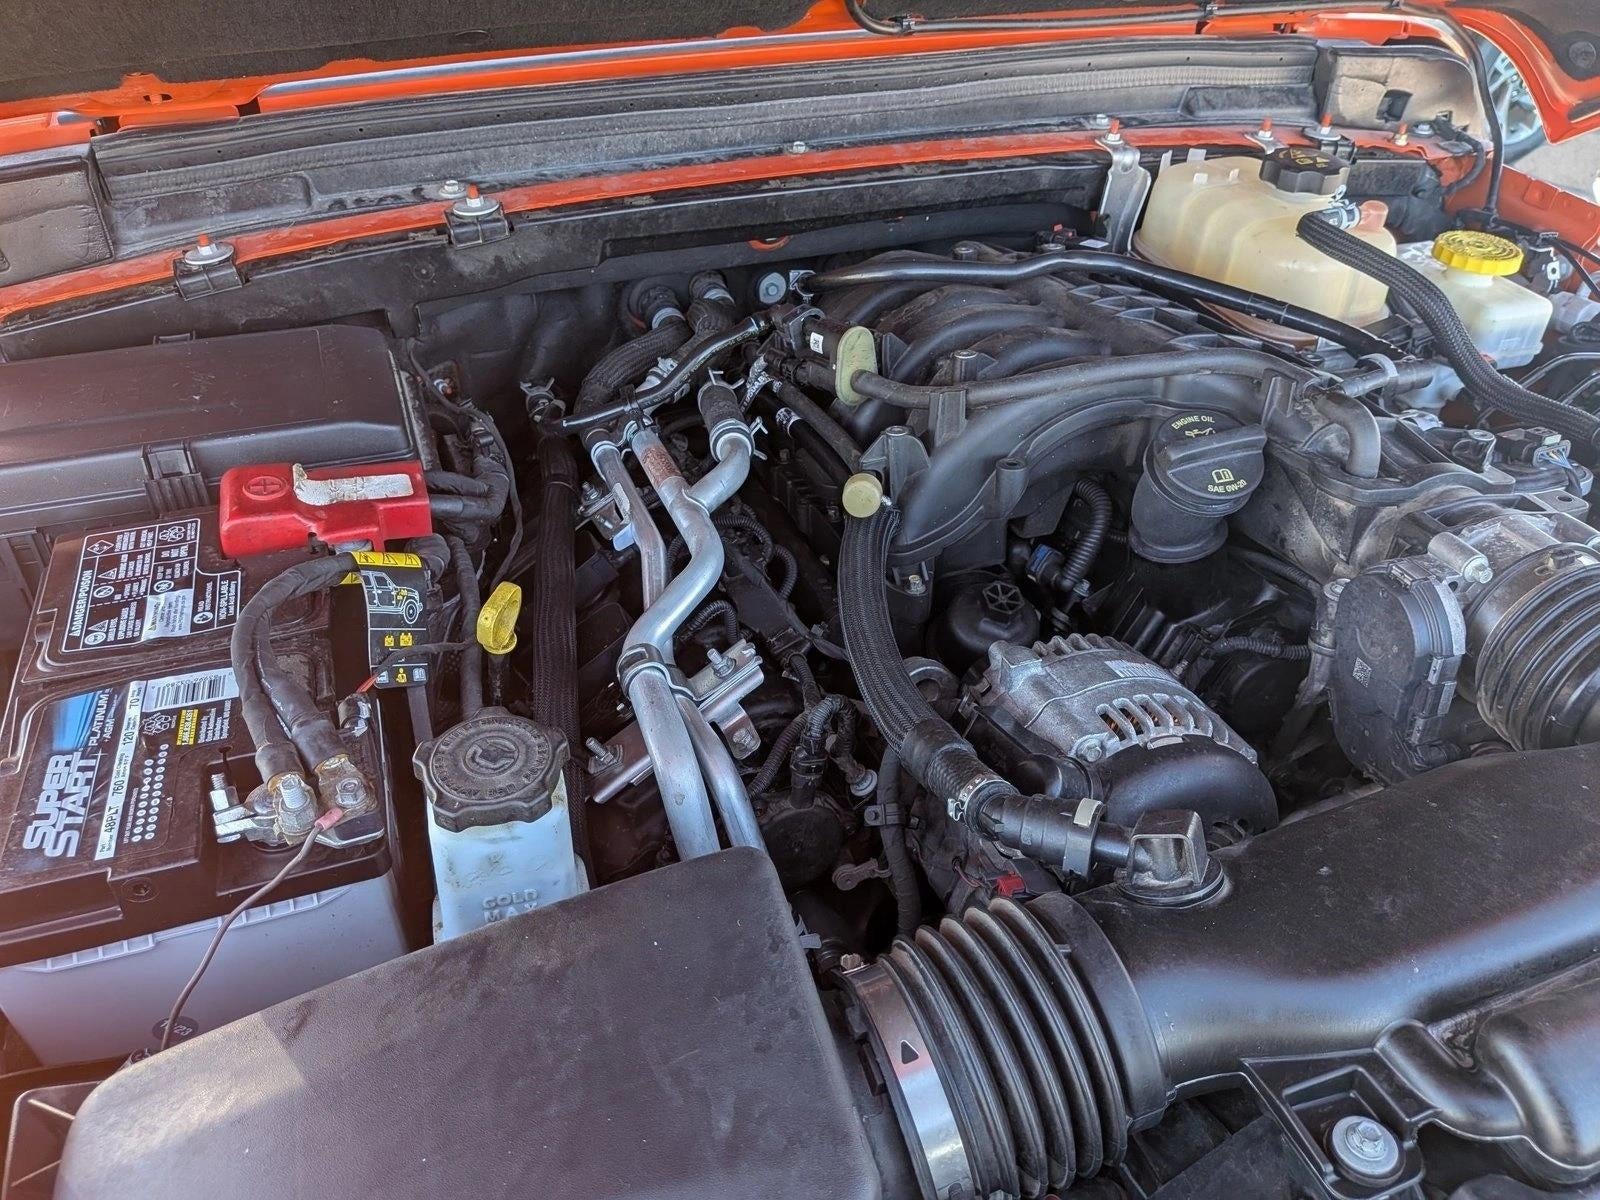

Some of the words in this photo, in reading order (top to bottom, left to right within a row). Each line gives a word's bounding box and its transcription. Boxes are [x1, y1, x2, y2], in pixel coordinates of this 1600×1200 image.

[1171, 415, 1200, 430] ENGINE
[1201, 415, 1215, 423] OIL
[1207, 484, 1225, 493] SAE
[1226, 479, 1247, 492] 0W-20
[72, 570, 92, 630] DANGER/POISON
[129, 698, 139, 709] 70
[88, 694, 109, 746] PLATINUM
[123, 731, 134, 745] 120
[112, 780, 124, 796] 760
[23, 754, 73, 849] SUPER
[44, 751, 97, 858] START
[104, 806, 119, 832] 48PLT
[482, 888, 538, 910] COLD
